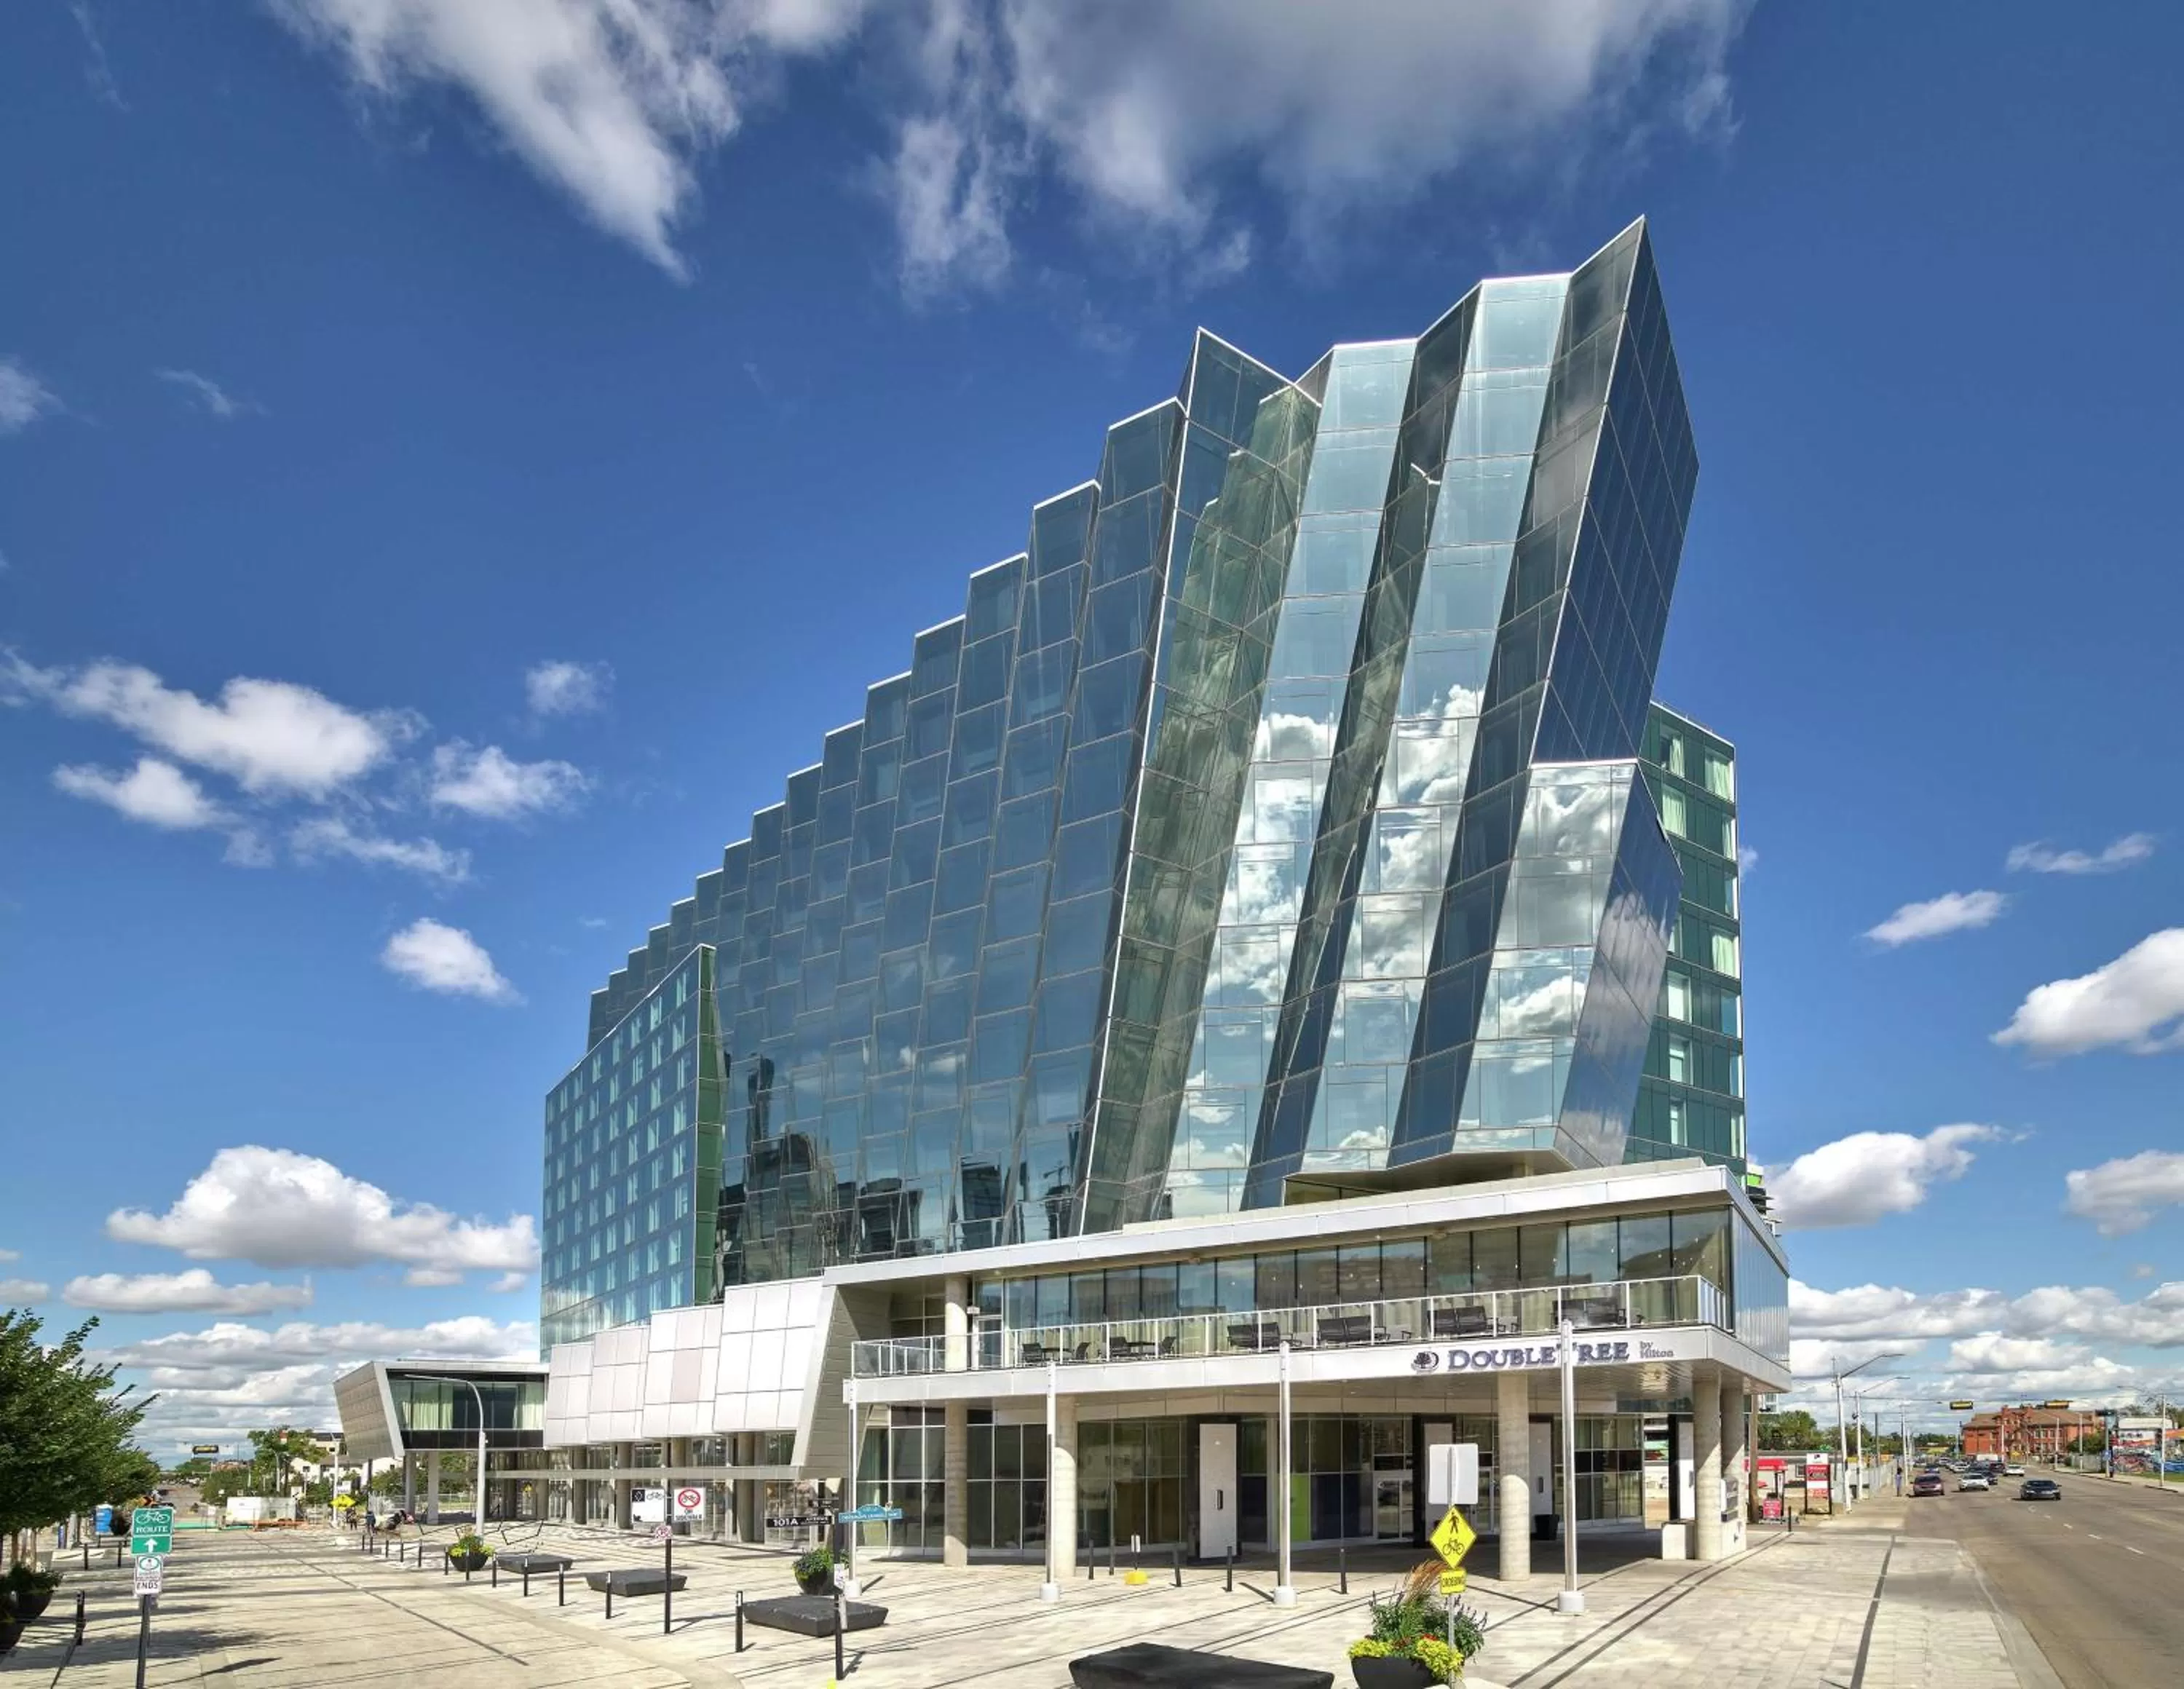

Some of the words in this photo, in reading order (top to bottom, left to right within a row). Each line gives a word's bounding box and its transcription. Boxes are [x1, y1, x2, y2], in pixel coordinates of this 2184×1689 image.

[1639, 1340, 1653, 1349] by
[1639, 1349, 1674, 1358] Hilton
[773, 1518, 799, 1527] 101A
[136, 1581, 158, 1589] ENDS
